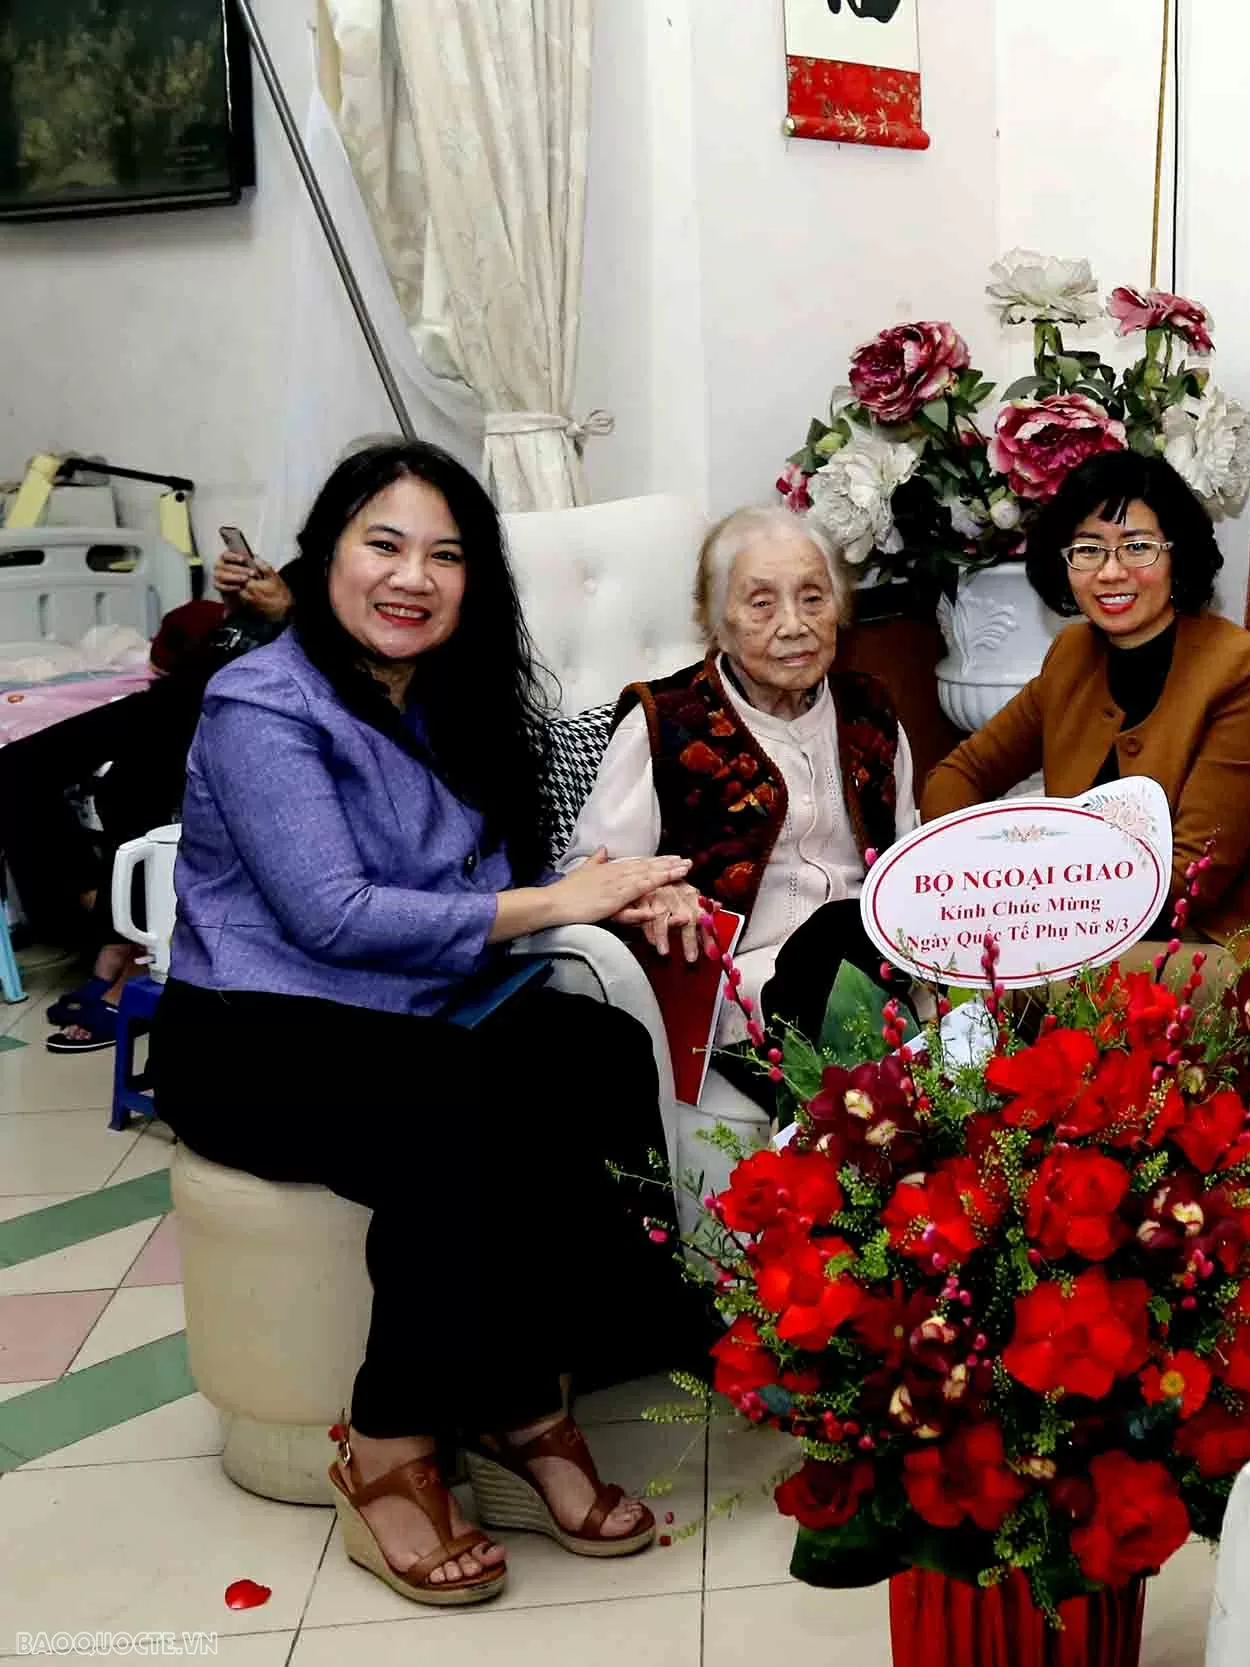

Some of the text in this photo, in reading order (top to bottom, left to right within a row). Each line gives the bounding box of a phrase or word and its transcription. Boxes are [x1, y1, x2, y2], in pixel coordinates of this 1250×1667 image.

[963, 865, 1054, 892] NGOẠI
[1063, 861, 1134, 882] GIAO
[941, 896, 1101, 921] Kính Chúc Mừng
[906, 933, 950, 952] Ngày
[1008, 921, 1030, 941] Tế
[1035, 923, 1068, 940] Phụ
[1075, 921, 1100, 936] Nữ
[1105, 917, 1129, 933] 8/3
